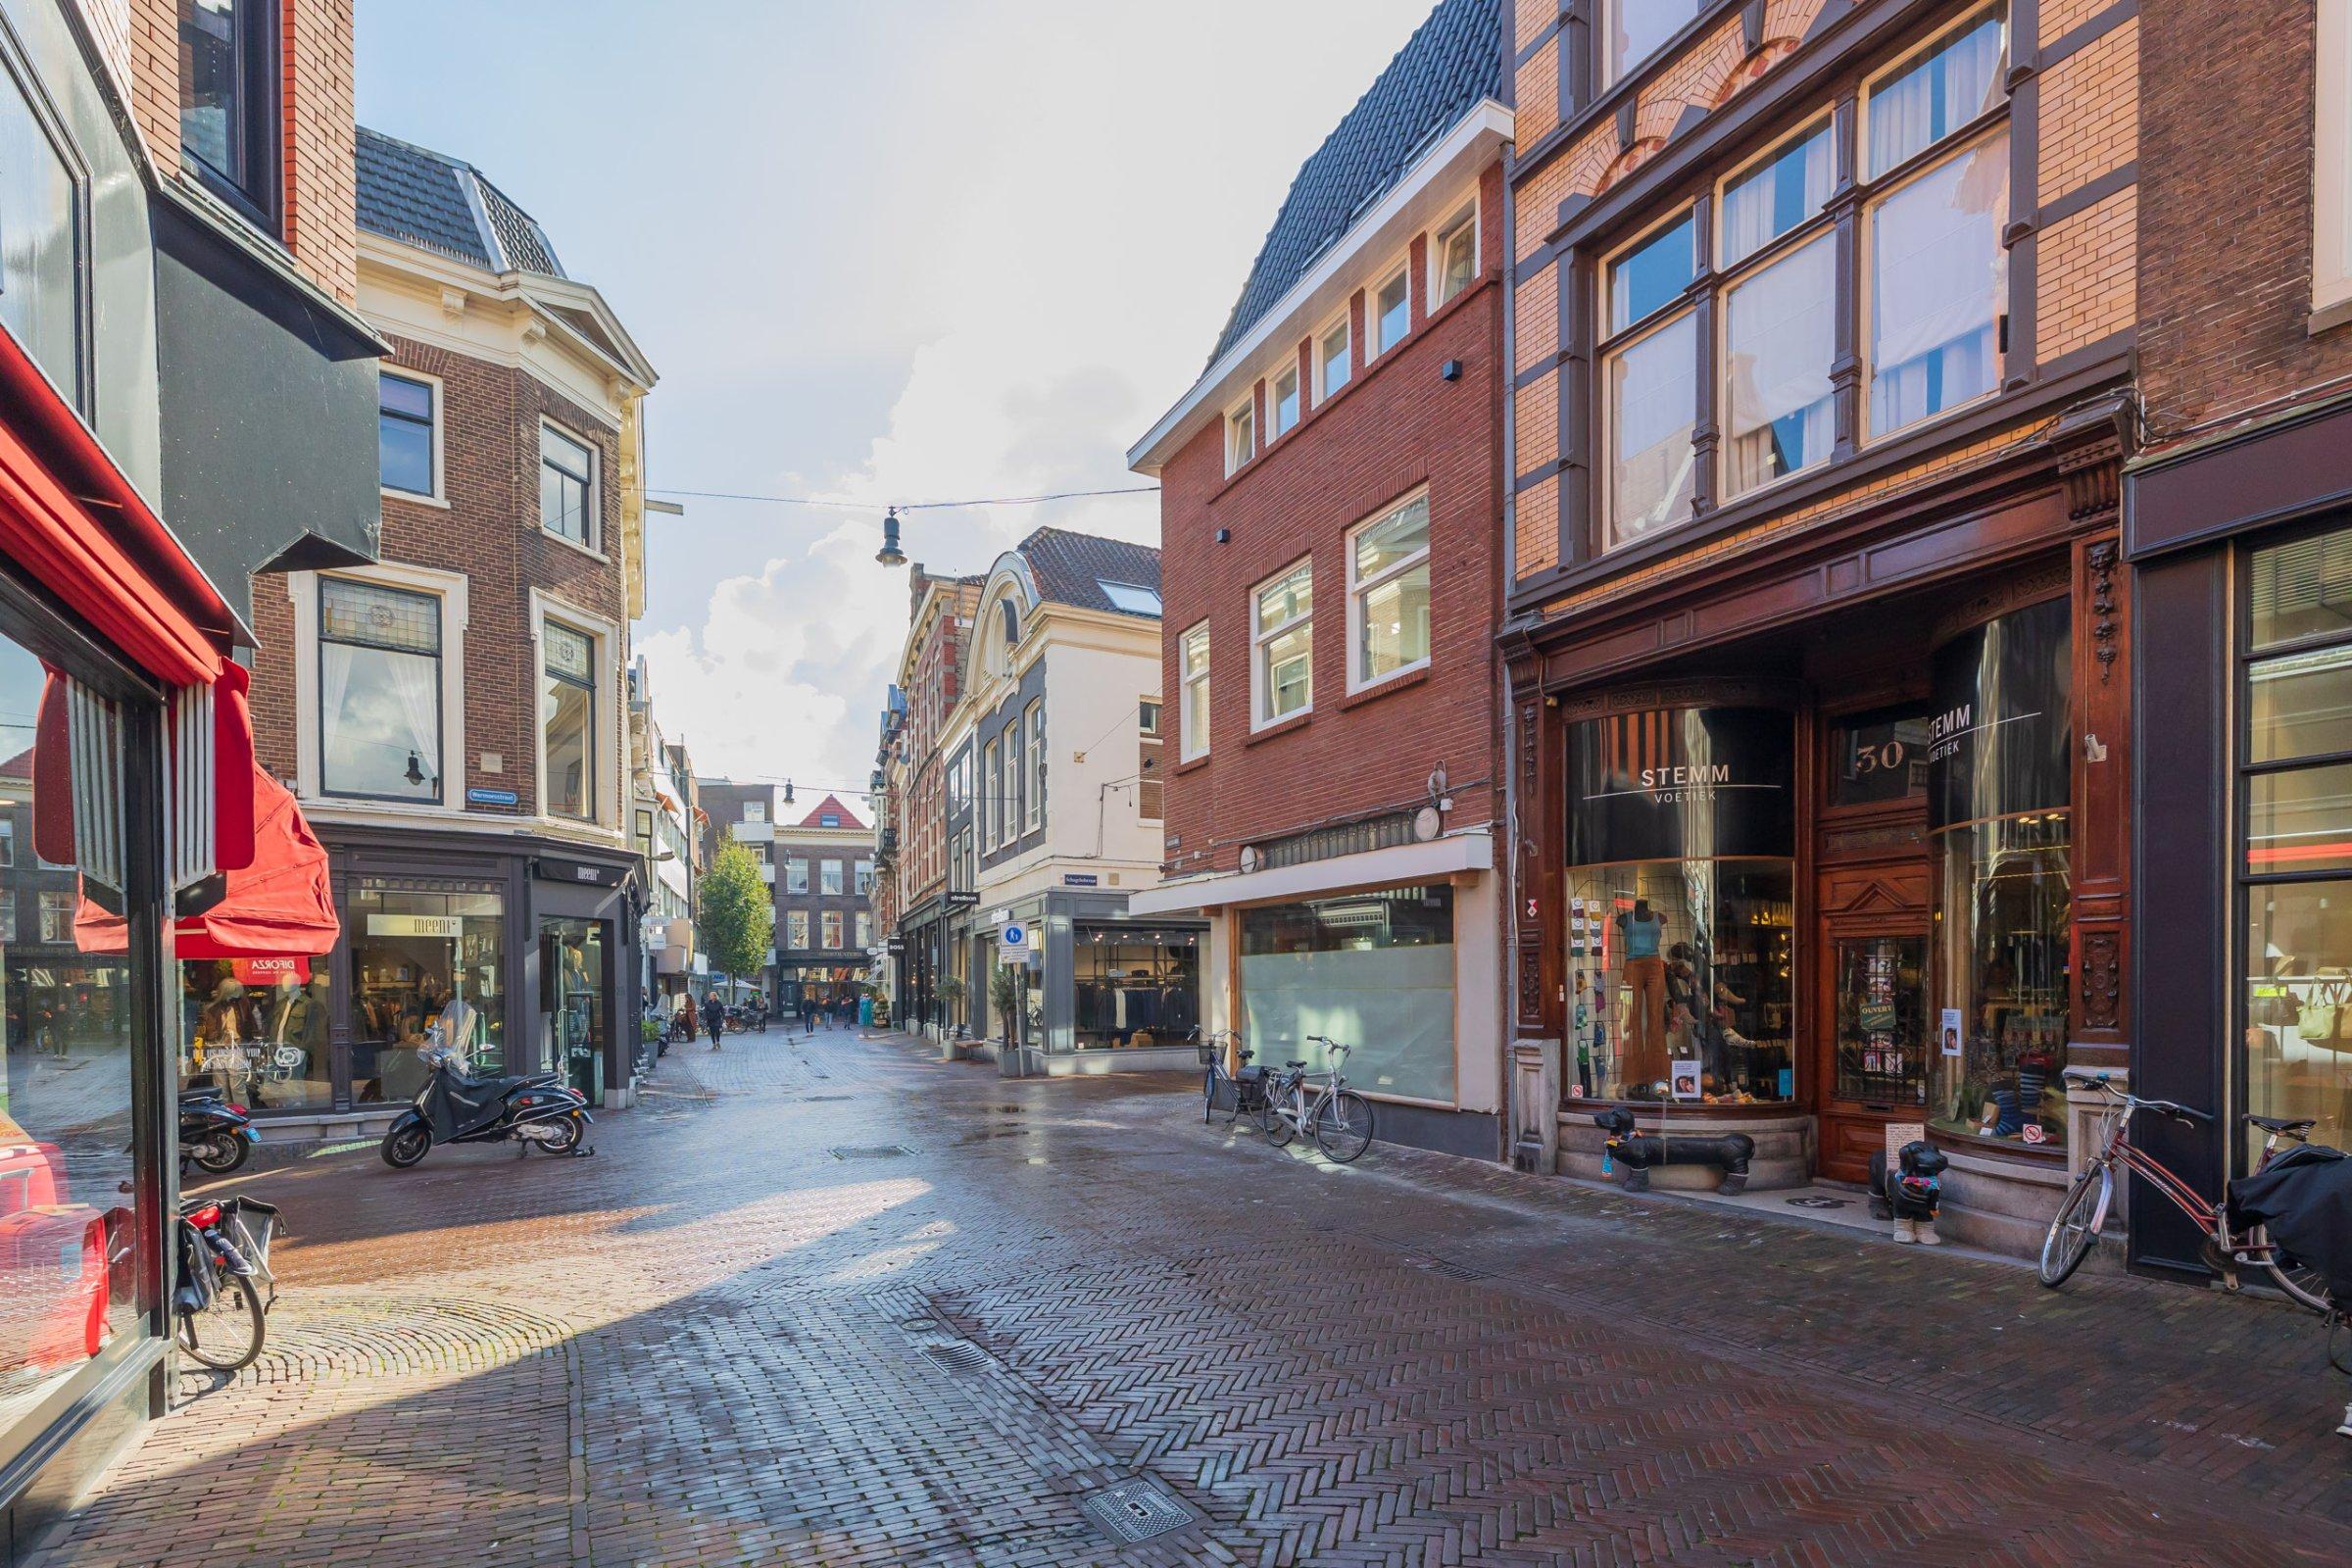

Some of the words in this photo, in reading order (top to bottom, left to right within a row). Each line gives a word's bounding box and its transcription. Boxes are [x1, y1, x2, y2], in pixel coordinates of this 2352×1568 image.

[1857, 741, 1904, 772] 30
[1642, 764, 1729, 787] STEMM
[1654, 791, 1716, 804] VOETIEK
[1862, 1004, 1892, 1014] OUVERT
